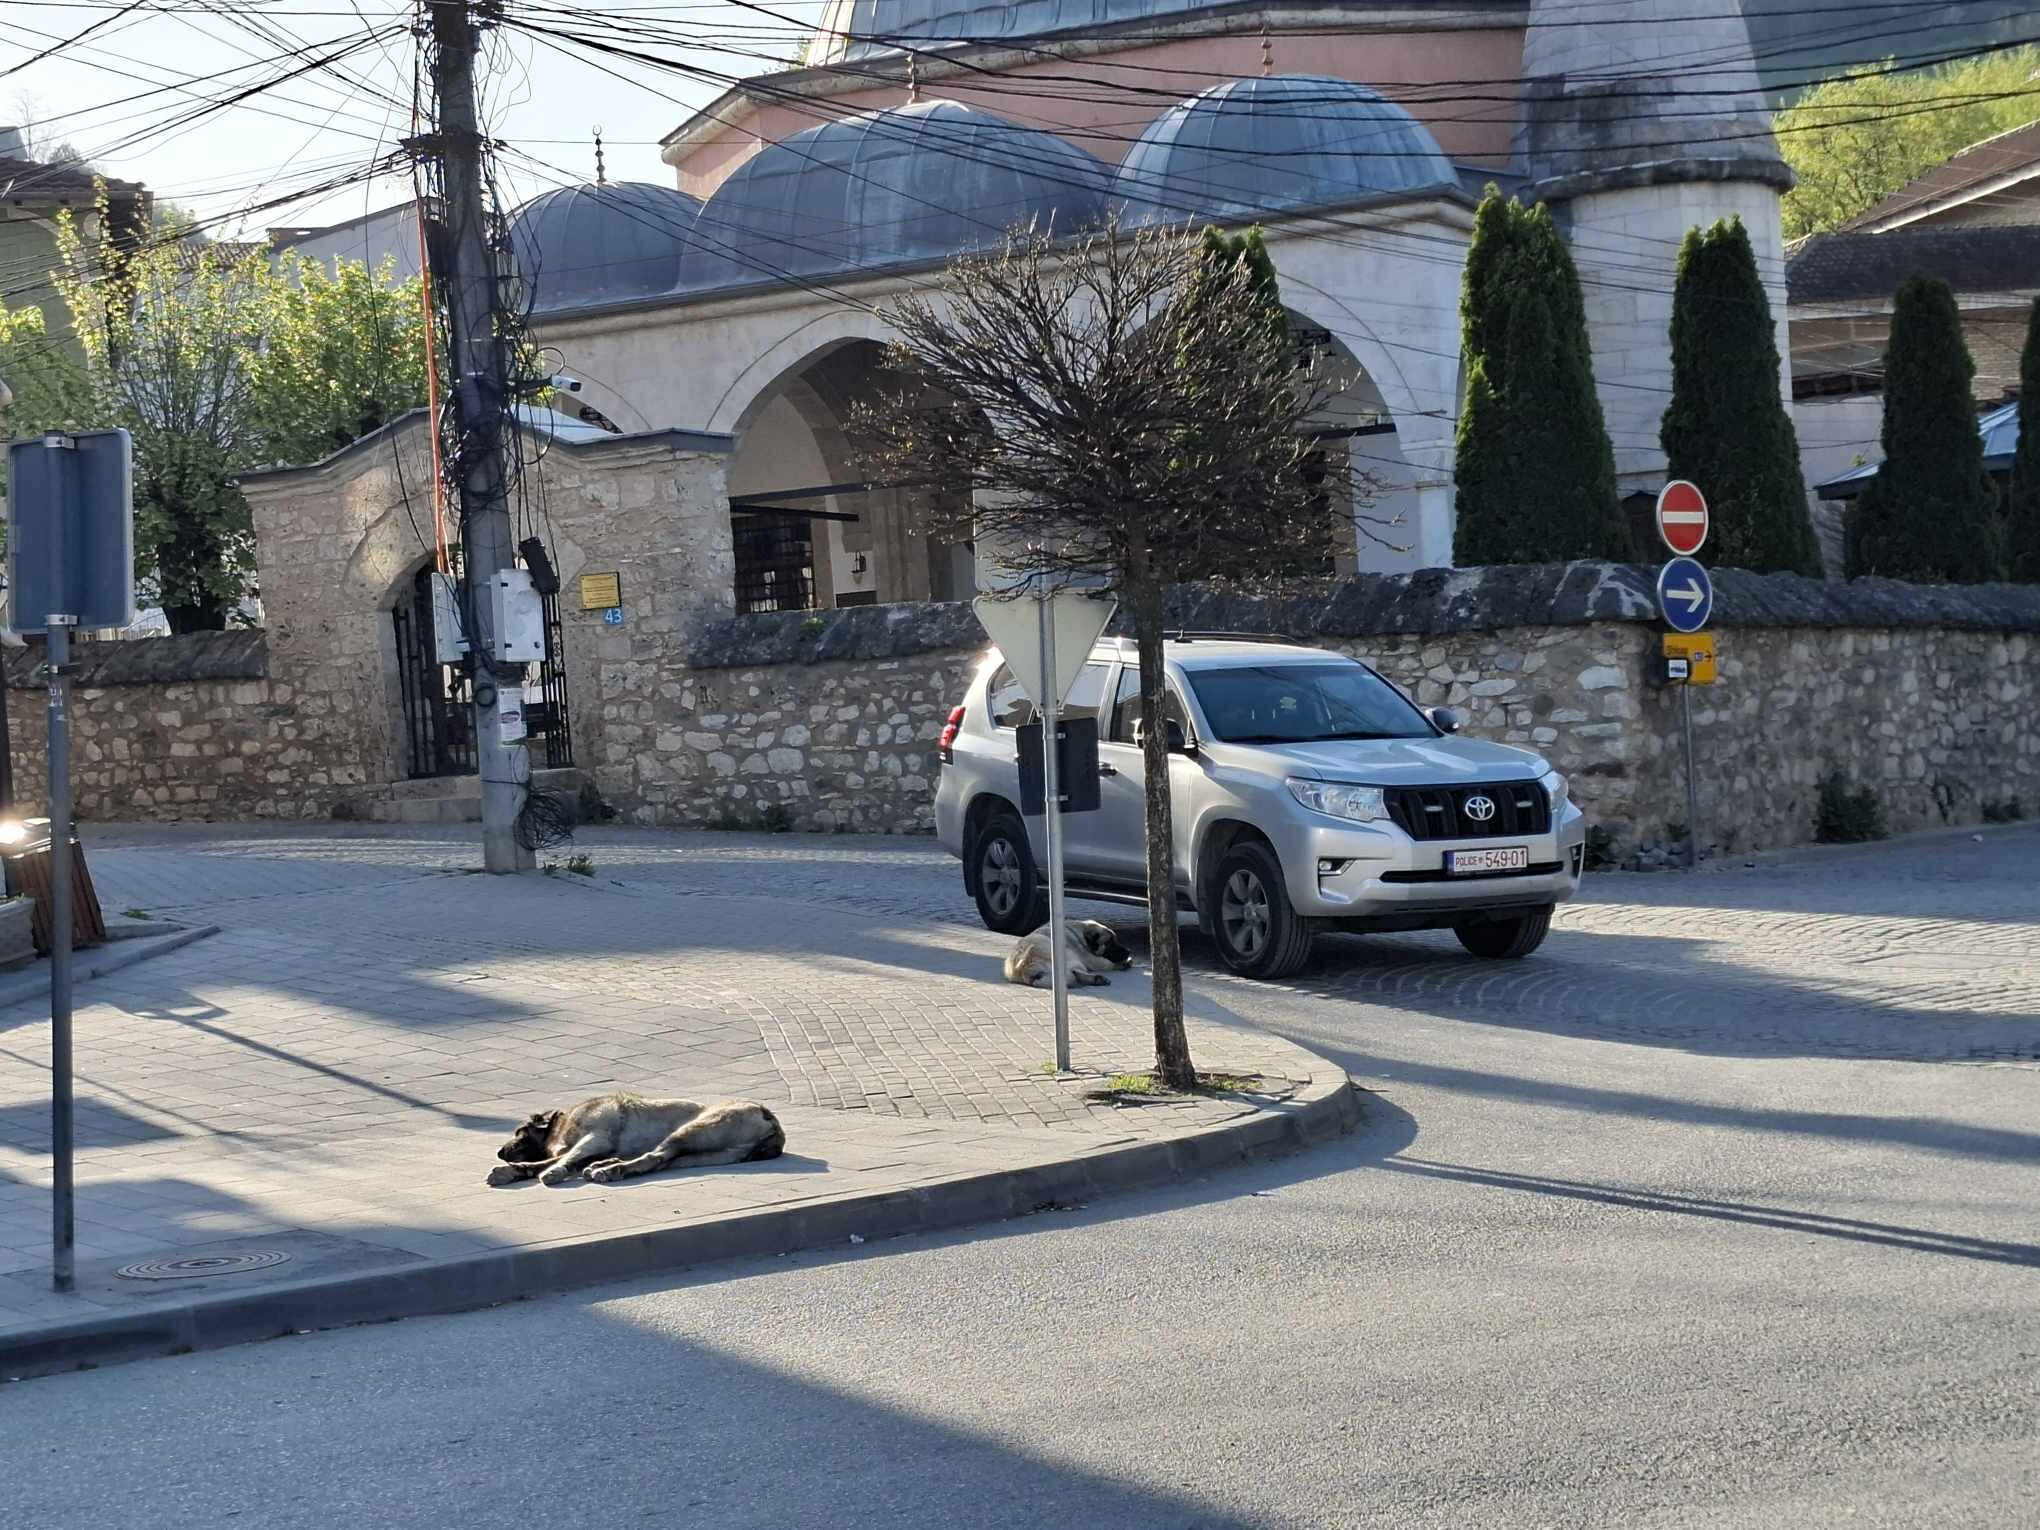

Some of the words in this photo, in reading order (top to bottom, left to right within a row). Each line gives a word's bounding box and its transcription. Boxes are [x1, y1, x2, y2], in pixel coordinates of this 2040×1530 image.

[605, 608, 622, 623] 43
[1456, 856, 1478, 866] POLICE
[1485, 850, 1525, 868] 549-01
